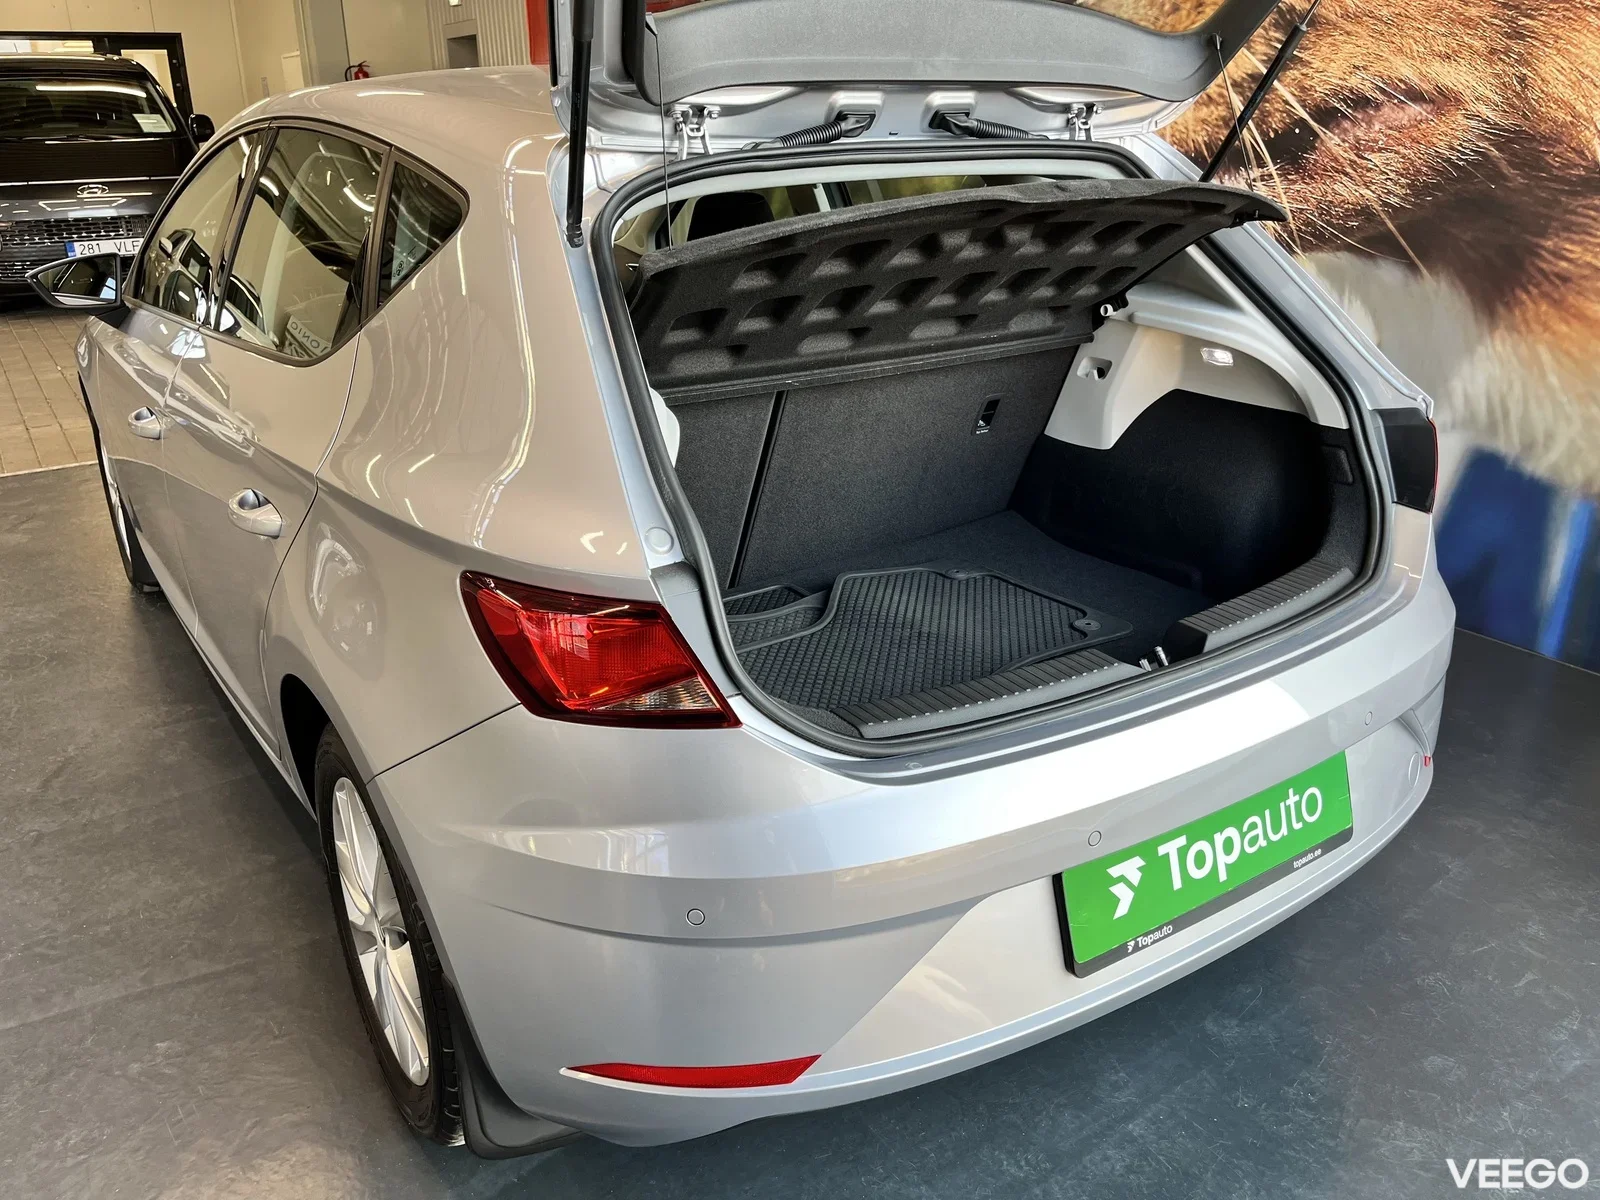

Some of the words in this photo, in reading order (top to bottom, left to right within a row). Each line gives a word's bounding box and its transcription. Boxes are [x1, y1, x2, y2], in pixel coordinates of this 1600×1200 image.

[79, 243, 101, 255] 281
[1157, 786, 1323, 892] Topauto
[1293, 848, 1322, 868] topauto.ee
[1136, 925, 1173, 948] Topauto
